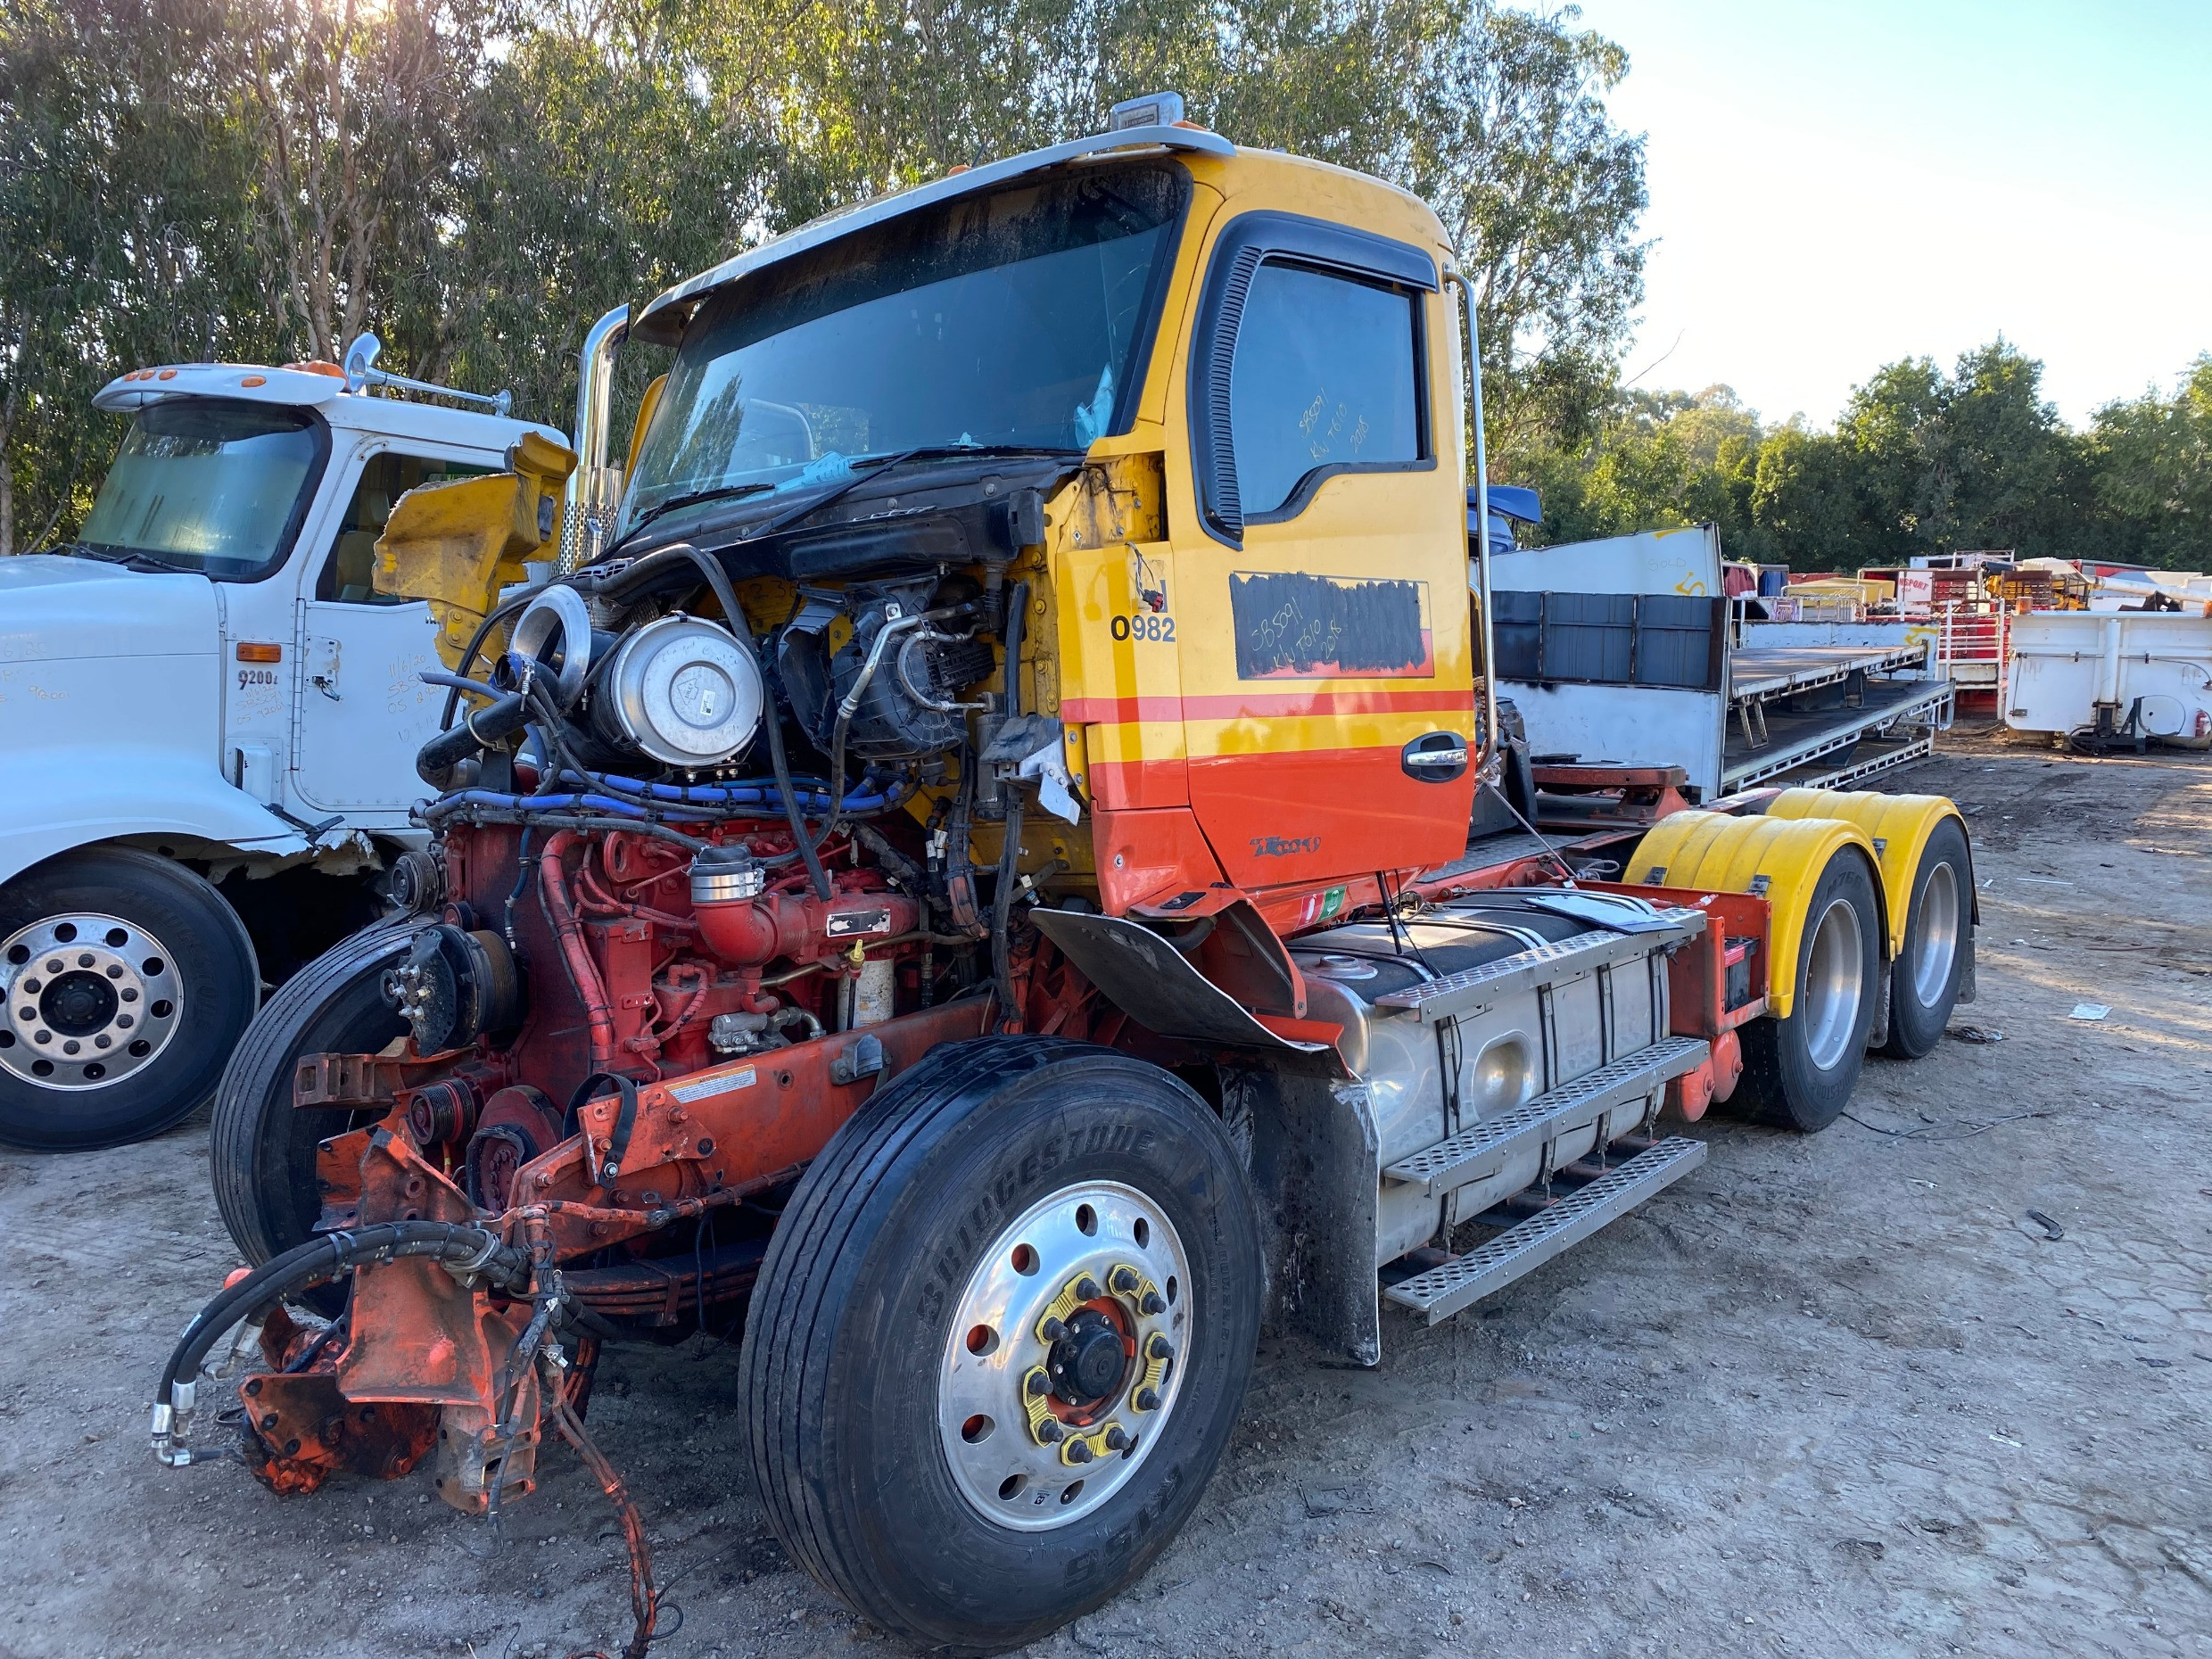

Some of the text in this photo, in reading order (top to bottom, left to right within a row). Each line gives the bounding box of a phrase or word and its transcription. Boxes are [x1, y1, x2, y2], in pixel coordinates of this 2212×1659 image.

[1110, 615, 1176, 642] 0982
[1321, 615, 1342, 659] 2018
[238, 670, 278, 690] 9200i
